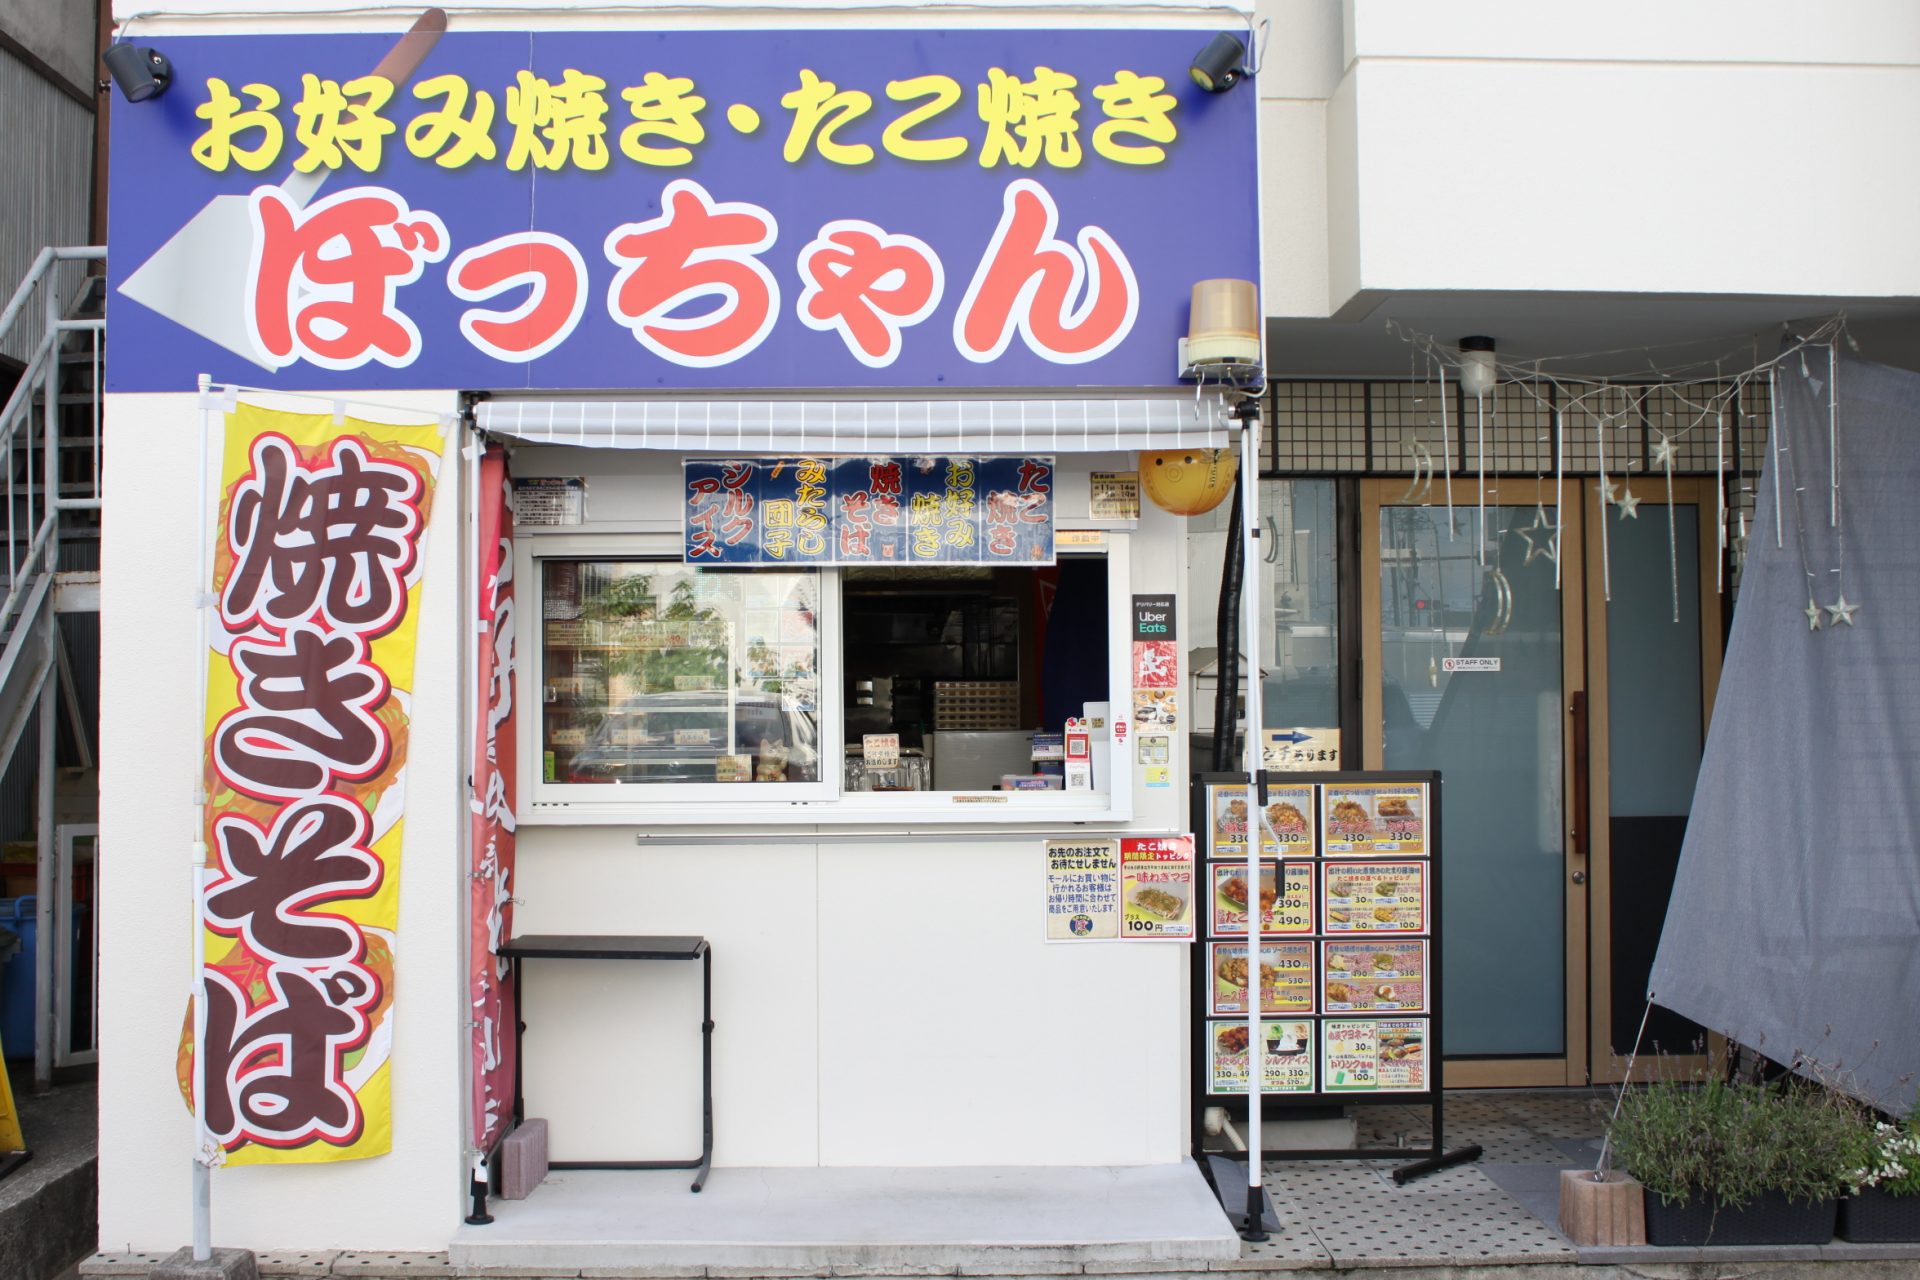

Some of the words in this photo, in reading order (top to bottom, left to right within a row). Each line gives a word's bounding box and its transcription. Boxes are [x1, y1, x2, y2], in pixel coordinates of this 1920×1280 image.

[191, 66, 1178, 173] お好み焼き・たこ焼き
[869, 462, 902, 526] 焼き
[721, 462, 754, 546] シルク
[796, 459, 827, 556] みたらし
[944, 460, 976, 549] お好み
[688, 477, 721, 558] アイス
[763, 499, 796, 560] 団子
[840, 491, 872, 557] そば
[911, 493, 943, 558] 焼き
[1139, 611, 1167, 623] Uber
[1139, 622, 1168, 634] Eats
[203, 431, 425, 1149] 焼きそば
[1048, 847, 1110, 858] お先のお注文で
[1051, 858, 1117, 870] お待たせしません
[1048, 873, 1117, 883] モールにお買い物に
[1124, 871, 1190, 883] 一味ねぎマヨ
[1053, 883, 1112, 893] 行かれるお客様は
[1285, 882, 1308, 892] 30円
[1049, 894, 1117, 903] お帰り時間に合わせて
[1278, 899, 1308, 909] 390円
[1355, 896, 1373, 904] 30円
[1226, 909, 1274, 923] たこき
[1278, 916, 1308, 926] 490円
[1128, 920, 1163, 932] 100円
[1278, 959, 1308, 969] 430円
[1355, 1043, 1372, 1051] 30円
[1265, 1055, 1310, 1066] シルクアイス
[1353, 1073, 1375, 1081] 100円
